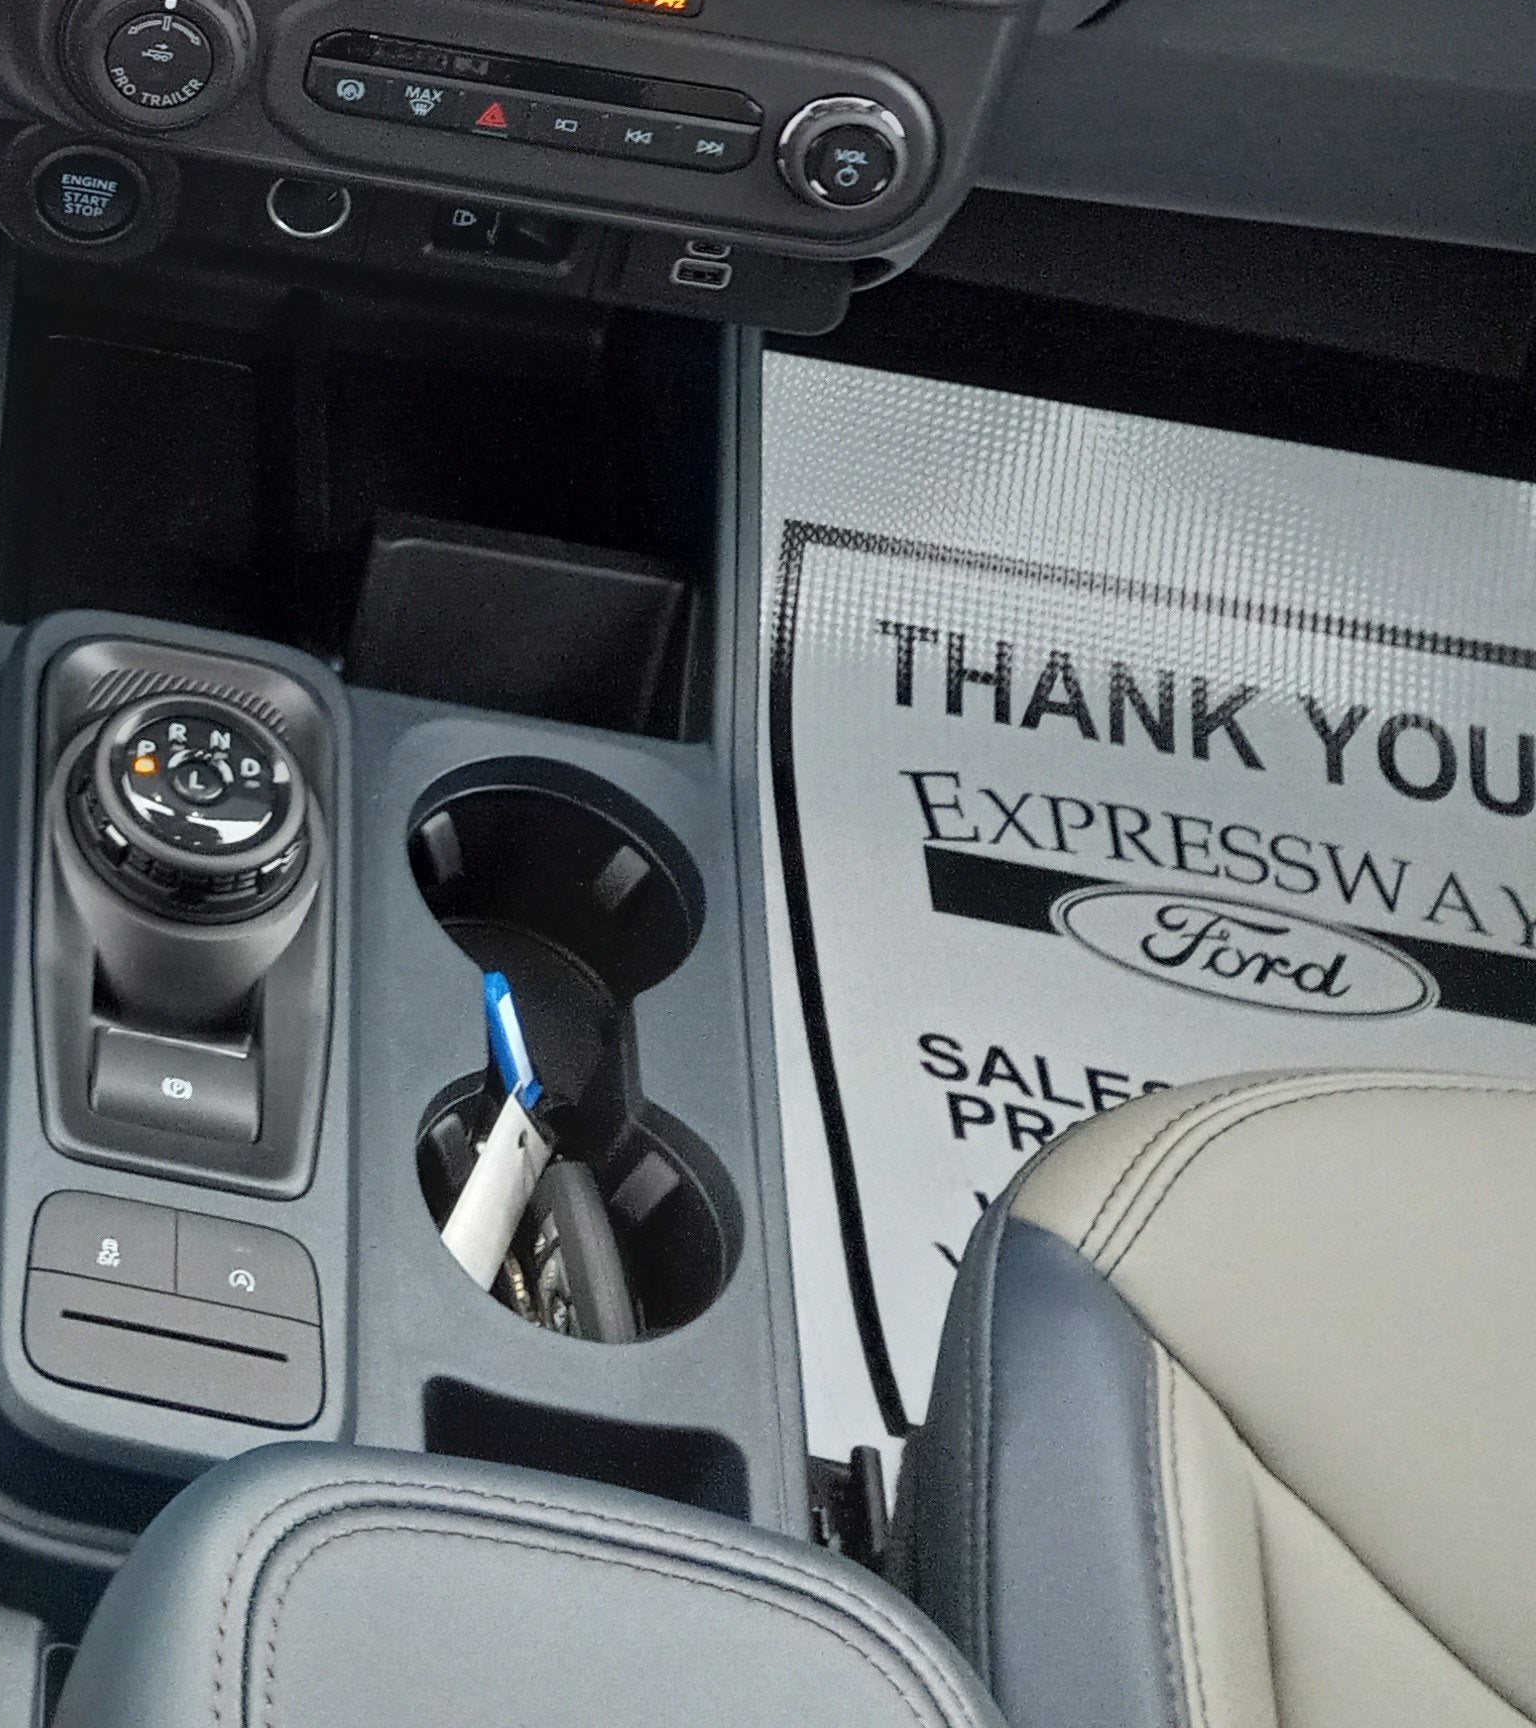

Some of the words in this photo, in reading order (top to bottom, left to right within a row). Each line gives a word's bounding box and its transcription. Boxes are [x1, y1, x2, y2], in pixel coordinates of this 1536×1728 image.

[110, 66, 137, 96] PRO
[140, 78, 204, 107] TRAILER
[403, 85, 444, 103] MAX
[834, 148, 869, 165] VOL
[61, 173, 119, 193] ENGINE
[62, 191, 111, 209] START
[64, 202, 104, 218] STOP
[876, 618, 1266, 772] THANK
[1296, 692, 1536, 818] YOU
[168, 723, 188, 743] R
[209, 729, 232, 750] N
[137, 739, 157, 757] P
[240, 757, 261, 778] D
[189, 770, 206, 790] L
[1141, 903, 1350, 1000] Ford
[918, 1032, 1172, 1114] SALE
